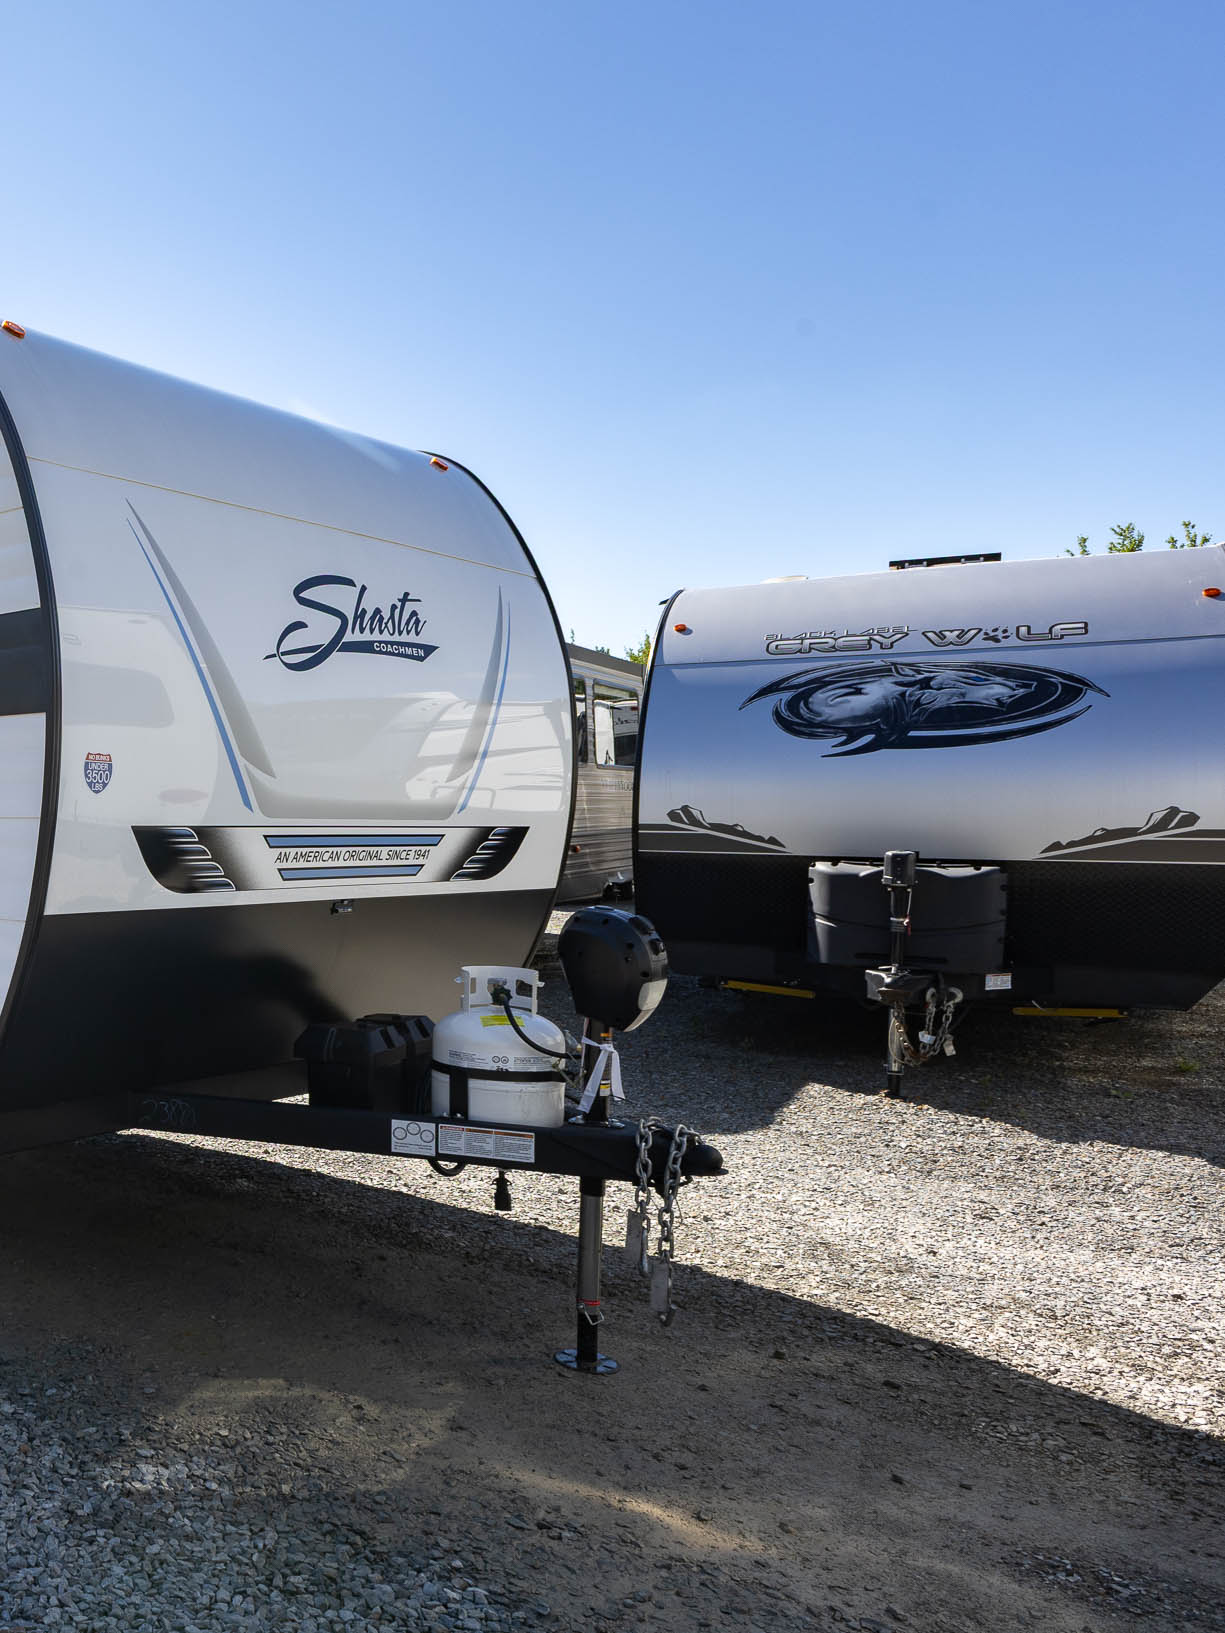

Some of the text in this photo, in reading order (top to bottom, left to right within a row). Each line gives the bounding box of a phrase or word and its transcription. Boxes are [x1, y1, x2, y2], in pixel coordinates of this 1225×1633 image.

[276, 574, 427, 671] Shasta
[764, 625, 918, 641] BLACK LABEL
[373, 642, 425, 657] COACHMEN
[766, 632, 909, 655] GREY
[88, 762, 109, 770] UNDER
[86, 770, 110, 783] 3500
[91, 783, 104, 791] LBS
[275, 848, 431, 863] AN AMERICAN ORIGINAL SINCE 1941
